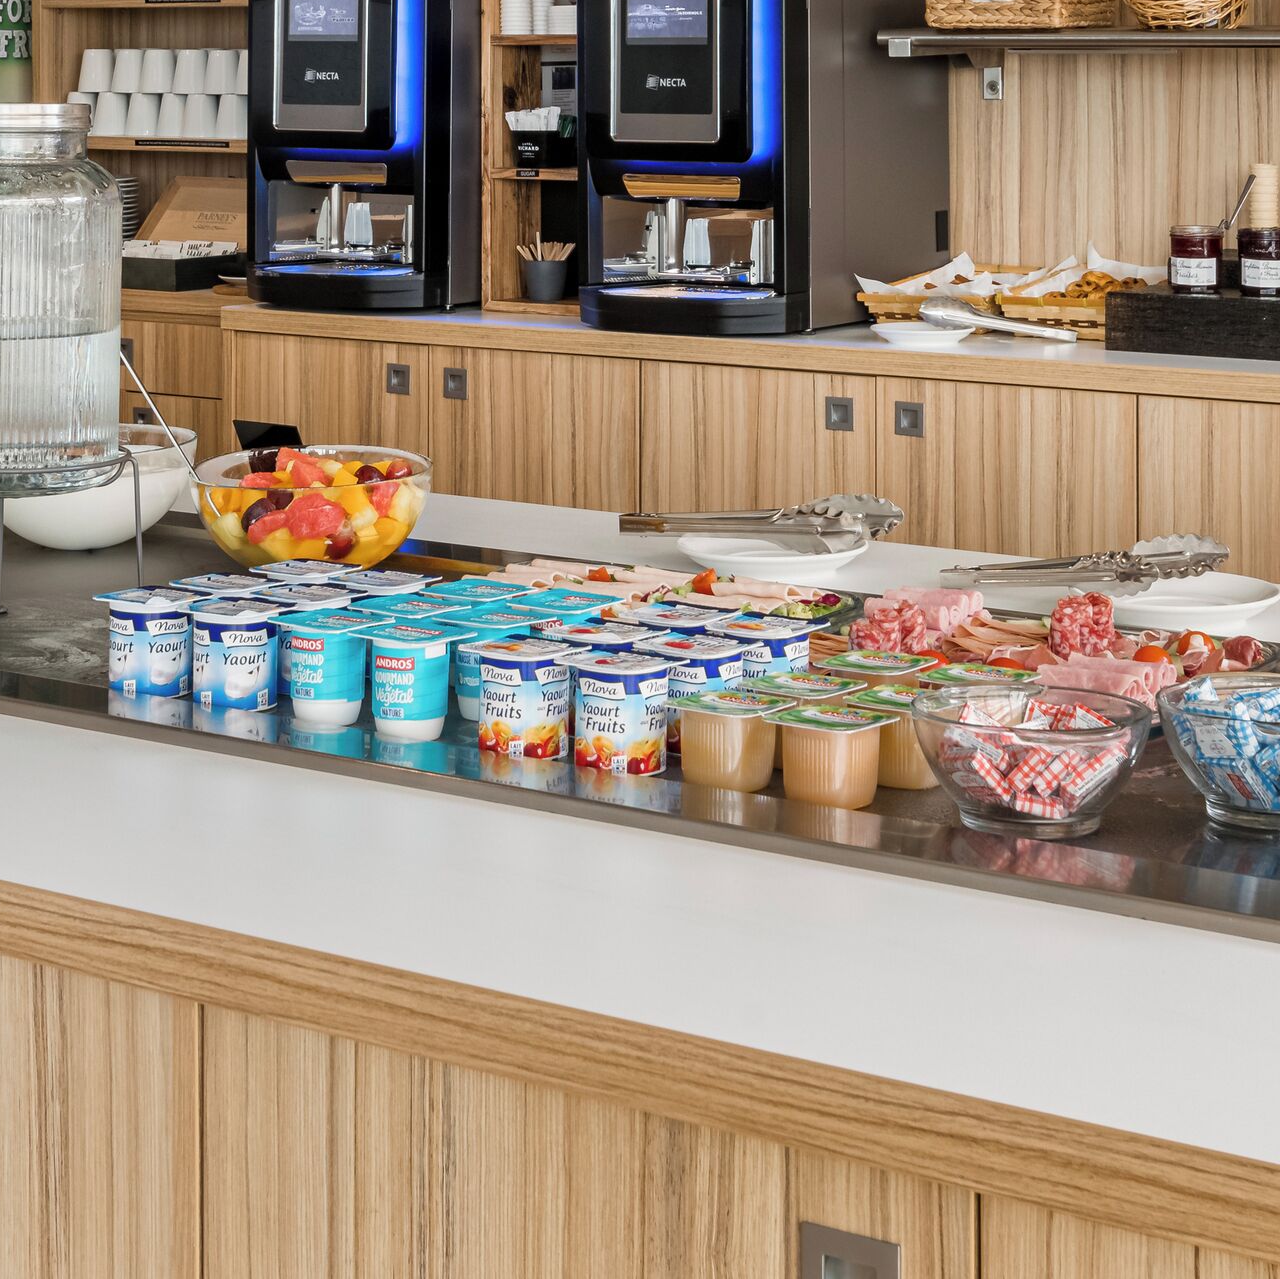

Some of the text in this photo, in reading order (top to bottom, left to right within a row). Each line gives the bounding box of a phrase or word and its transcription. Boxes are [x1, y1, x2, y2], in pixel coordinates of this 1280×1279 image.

[316, 72, 339, 80] NECTA
[660, 79, 686, 87] NECTA
[155, 621, 185, 631] Nova
[229, 632, 264, 644] Nova
[110, 641, 134, 653] ourt
[148, 638, 187, 653] Yaourt
[195, 652, 210, 663] urt
[223, 651, 267, 666] Yaourt
[742, 649, 766, 659] ova
[376, 657, 412, 669] ANDROS
[375, 671, 415, 686] GOURMAND
[483, 666, 514, 681] Nova
[742, 668, 767, 679] ourt
[584, 680, 617, 696] Nova
[375, 687, 414, 706] Végétal
[483, 687, 517, 703] Yaourt
[381, 708, 402, 717] NATURE
[485, 704, 522, 719] Fruits
[583, 701, 621, 717] Yaourt
[585, 718, 626, 734] Fruits
